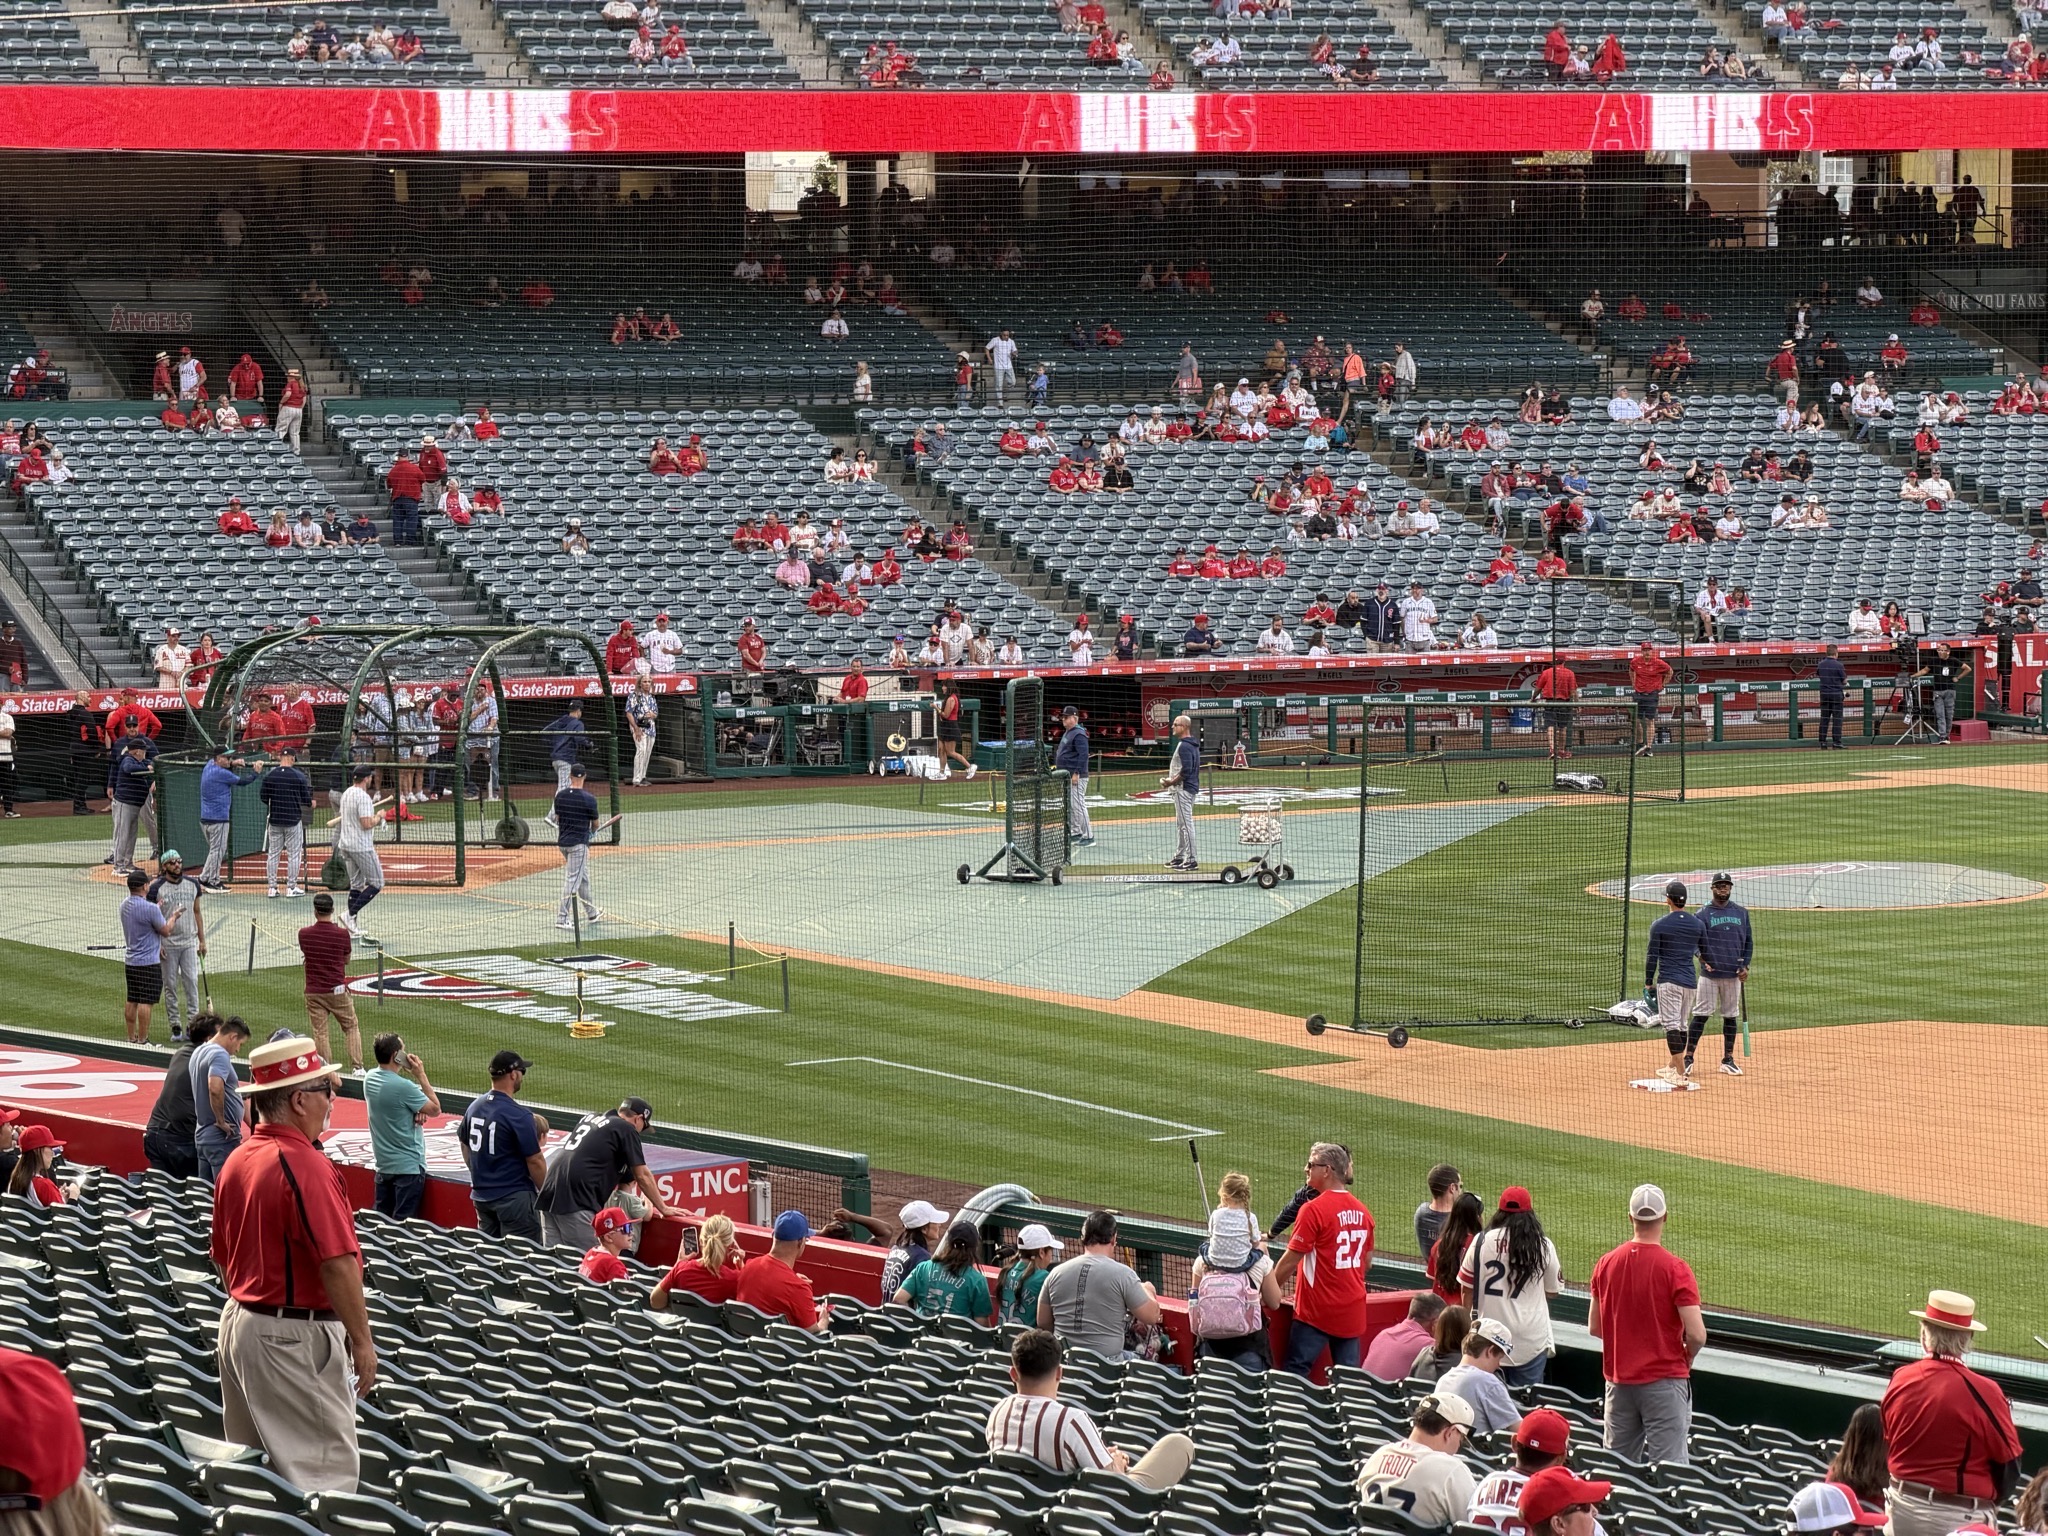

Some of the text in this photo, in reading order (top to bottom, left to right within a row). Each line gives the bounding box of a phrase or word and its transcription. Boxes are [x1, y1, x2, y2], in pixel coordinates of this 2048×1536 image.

[1975, 294, 2004, 309] YOU
[2011, 293, 2045, 308] FANS
[108, 303, 192, 332] ANGELS
[1736, 657, 1760, 667] ANGELS
[1869, 654, 1892, 663] ANGELS
[1984, 638, 2048, 669] SAL
[1248, 673, 1273, 682] ANGELS
[1317, 670, 1342, 680] ANGELS
[1444, 666, 1469, 676] ANGELS
[1262, 730, 1286, 738] ANGELS
[1710, 916, 1742, 928] MARINERS
[469, 1116, 496, 1155] 51
[690, 1167, 748, 1198] INC.
[1337, 1210, 1364, 1228] TROUT
[1336, 1229, 1368, 1270] 27
[1378, 1453, 1418, 1479] TROUT
[1476, 1478, 1522, 1509] CARE
